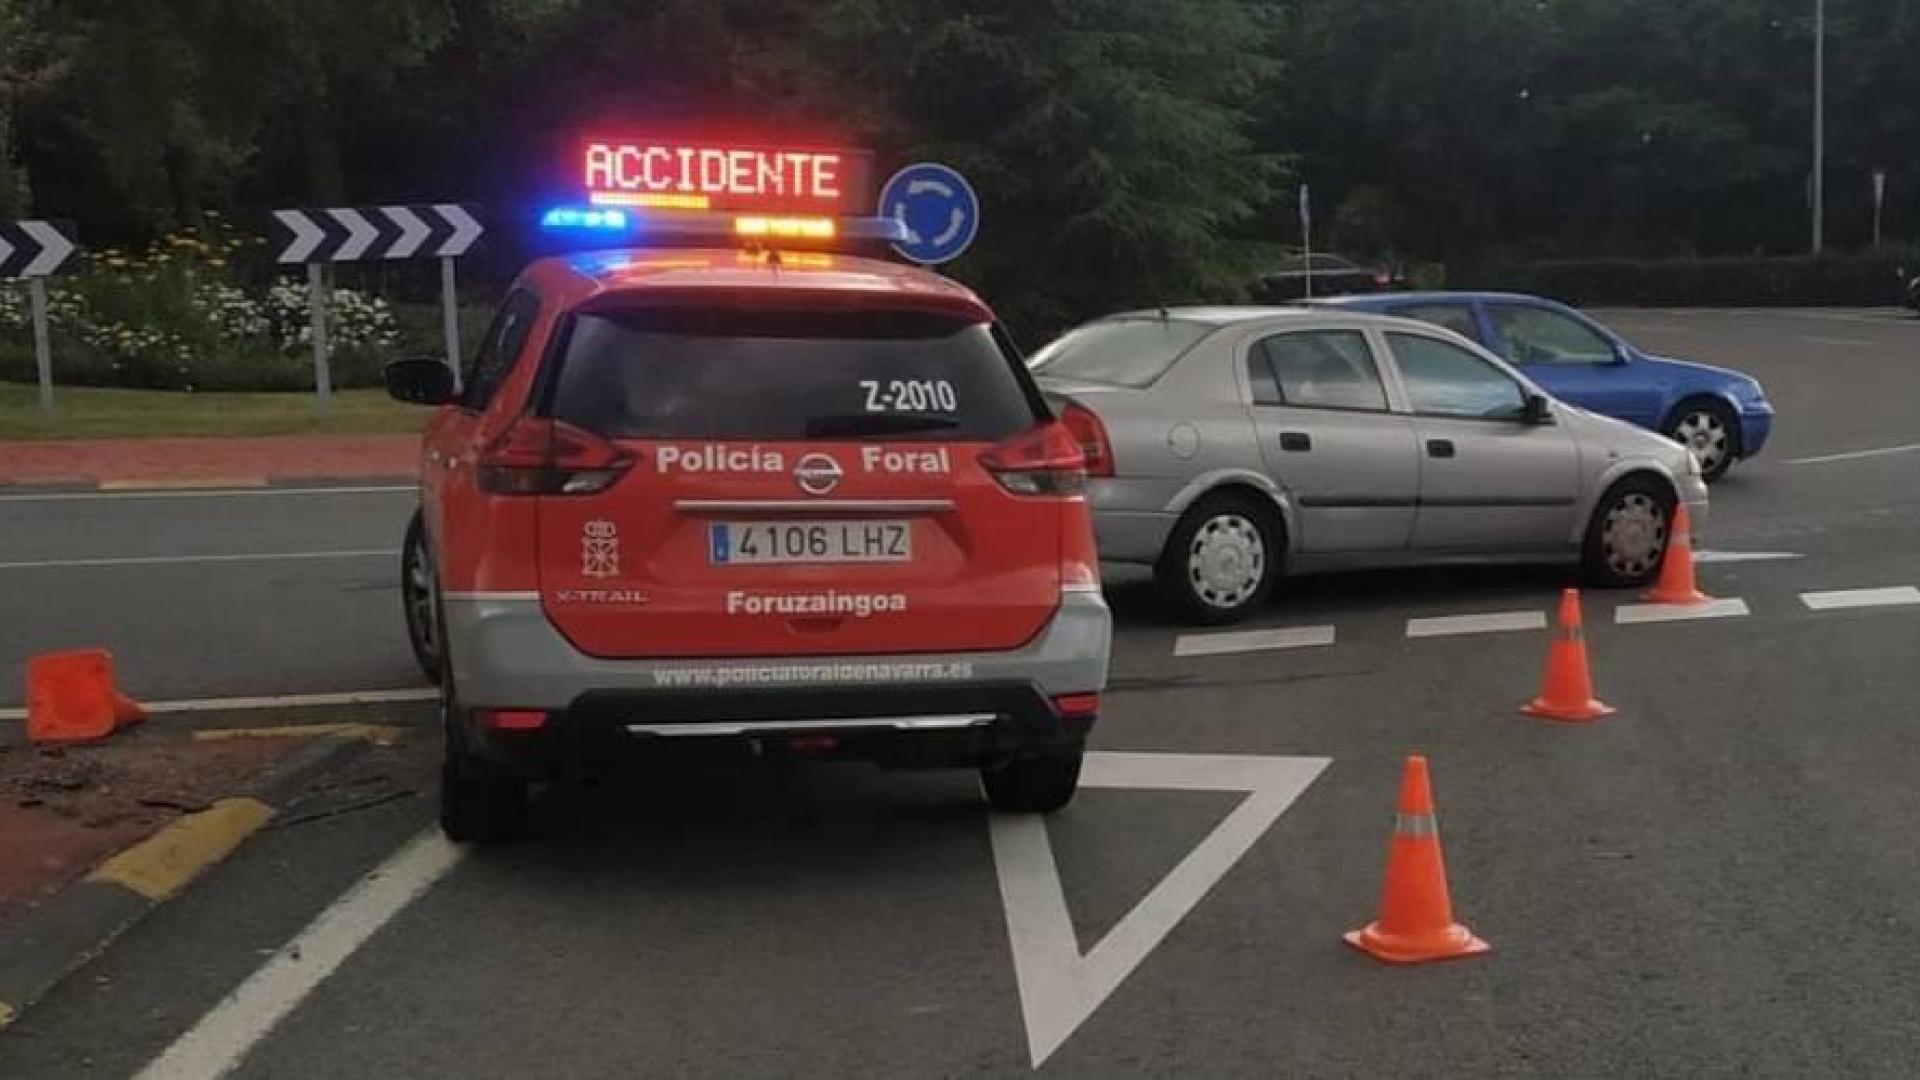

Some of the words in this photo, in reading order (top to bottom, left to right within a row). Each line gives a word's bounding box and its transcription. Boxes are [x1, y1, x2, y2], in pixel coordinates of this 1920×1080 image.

[586, 144, 840, 197] ACCIDENTE
[859, 380, 956, 411] Z-2010
[656, 445, 784, 473] Policía
[861, 445, 951, 473] Foral
[739, 526, 828, 557] 4106
[841, 526, 906, 556] LHZ
[556, 590, 651, 603] X-TRAIL
[726, 589, 907, 617] Foruzaingoa
